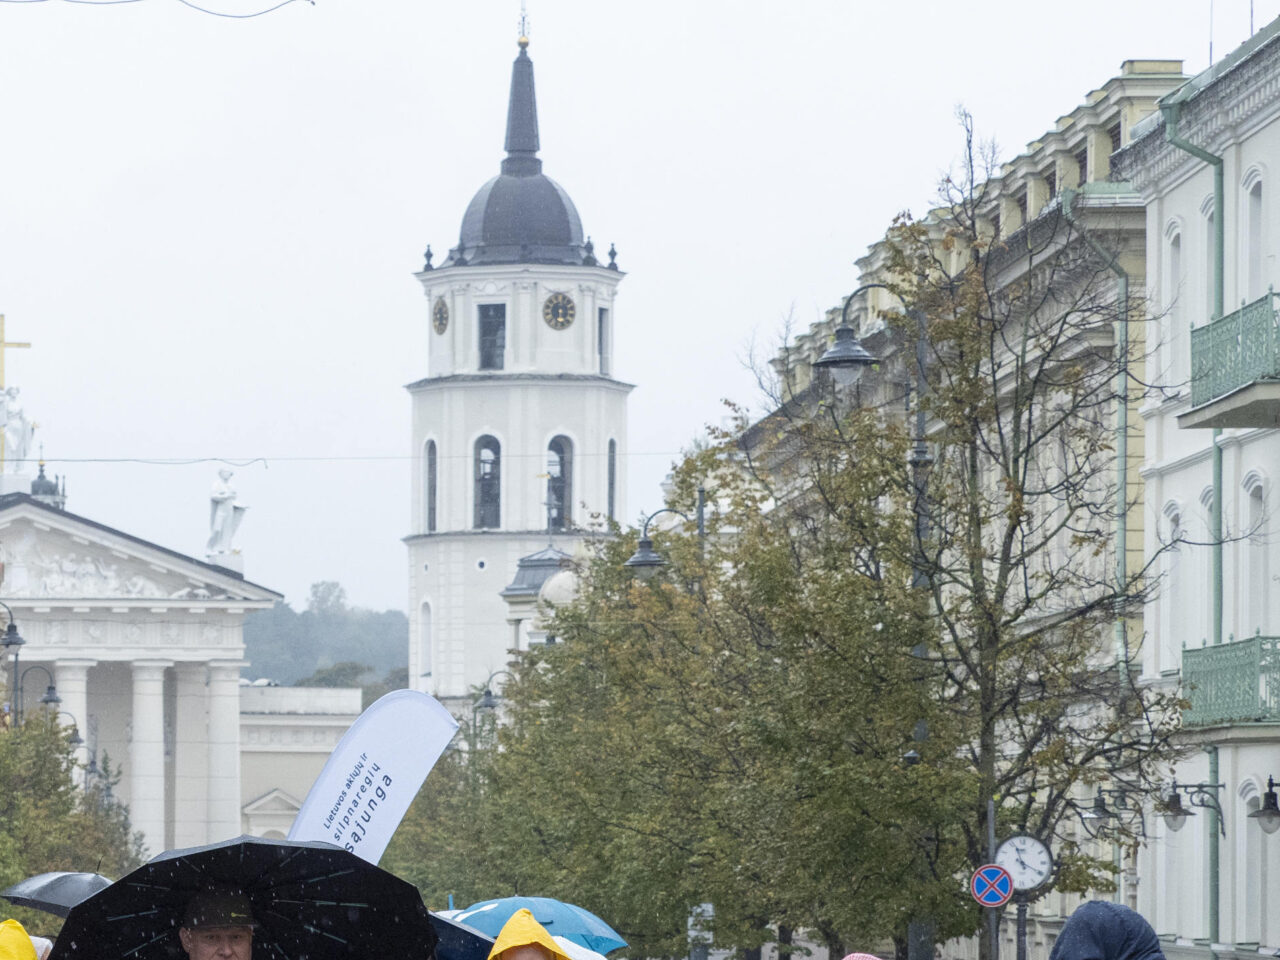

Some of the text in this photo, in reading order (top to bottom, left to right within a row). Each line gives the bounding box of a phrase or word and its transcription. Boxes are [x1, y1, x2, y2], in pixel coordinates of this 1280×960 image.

[323, 753, 368, 830] Lietuvos aklųjų ir
[333, 762, 381, 841] silpnaregių
[344, 774, 393, 853] sąjunga
